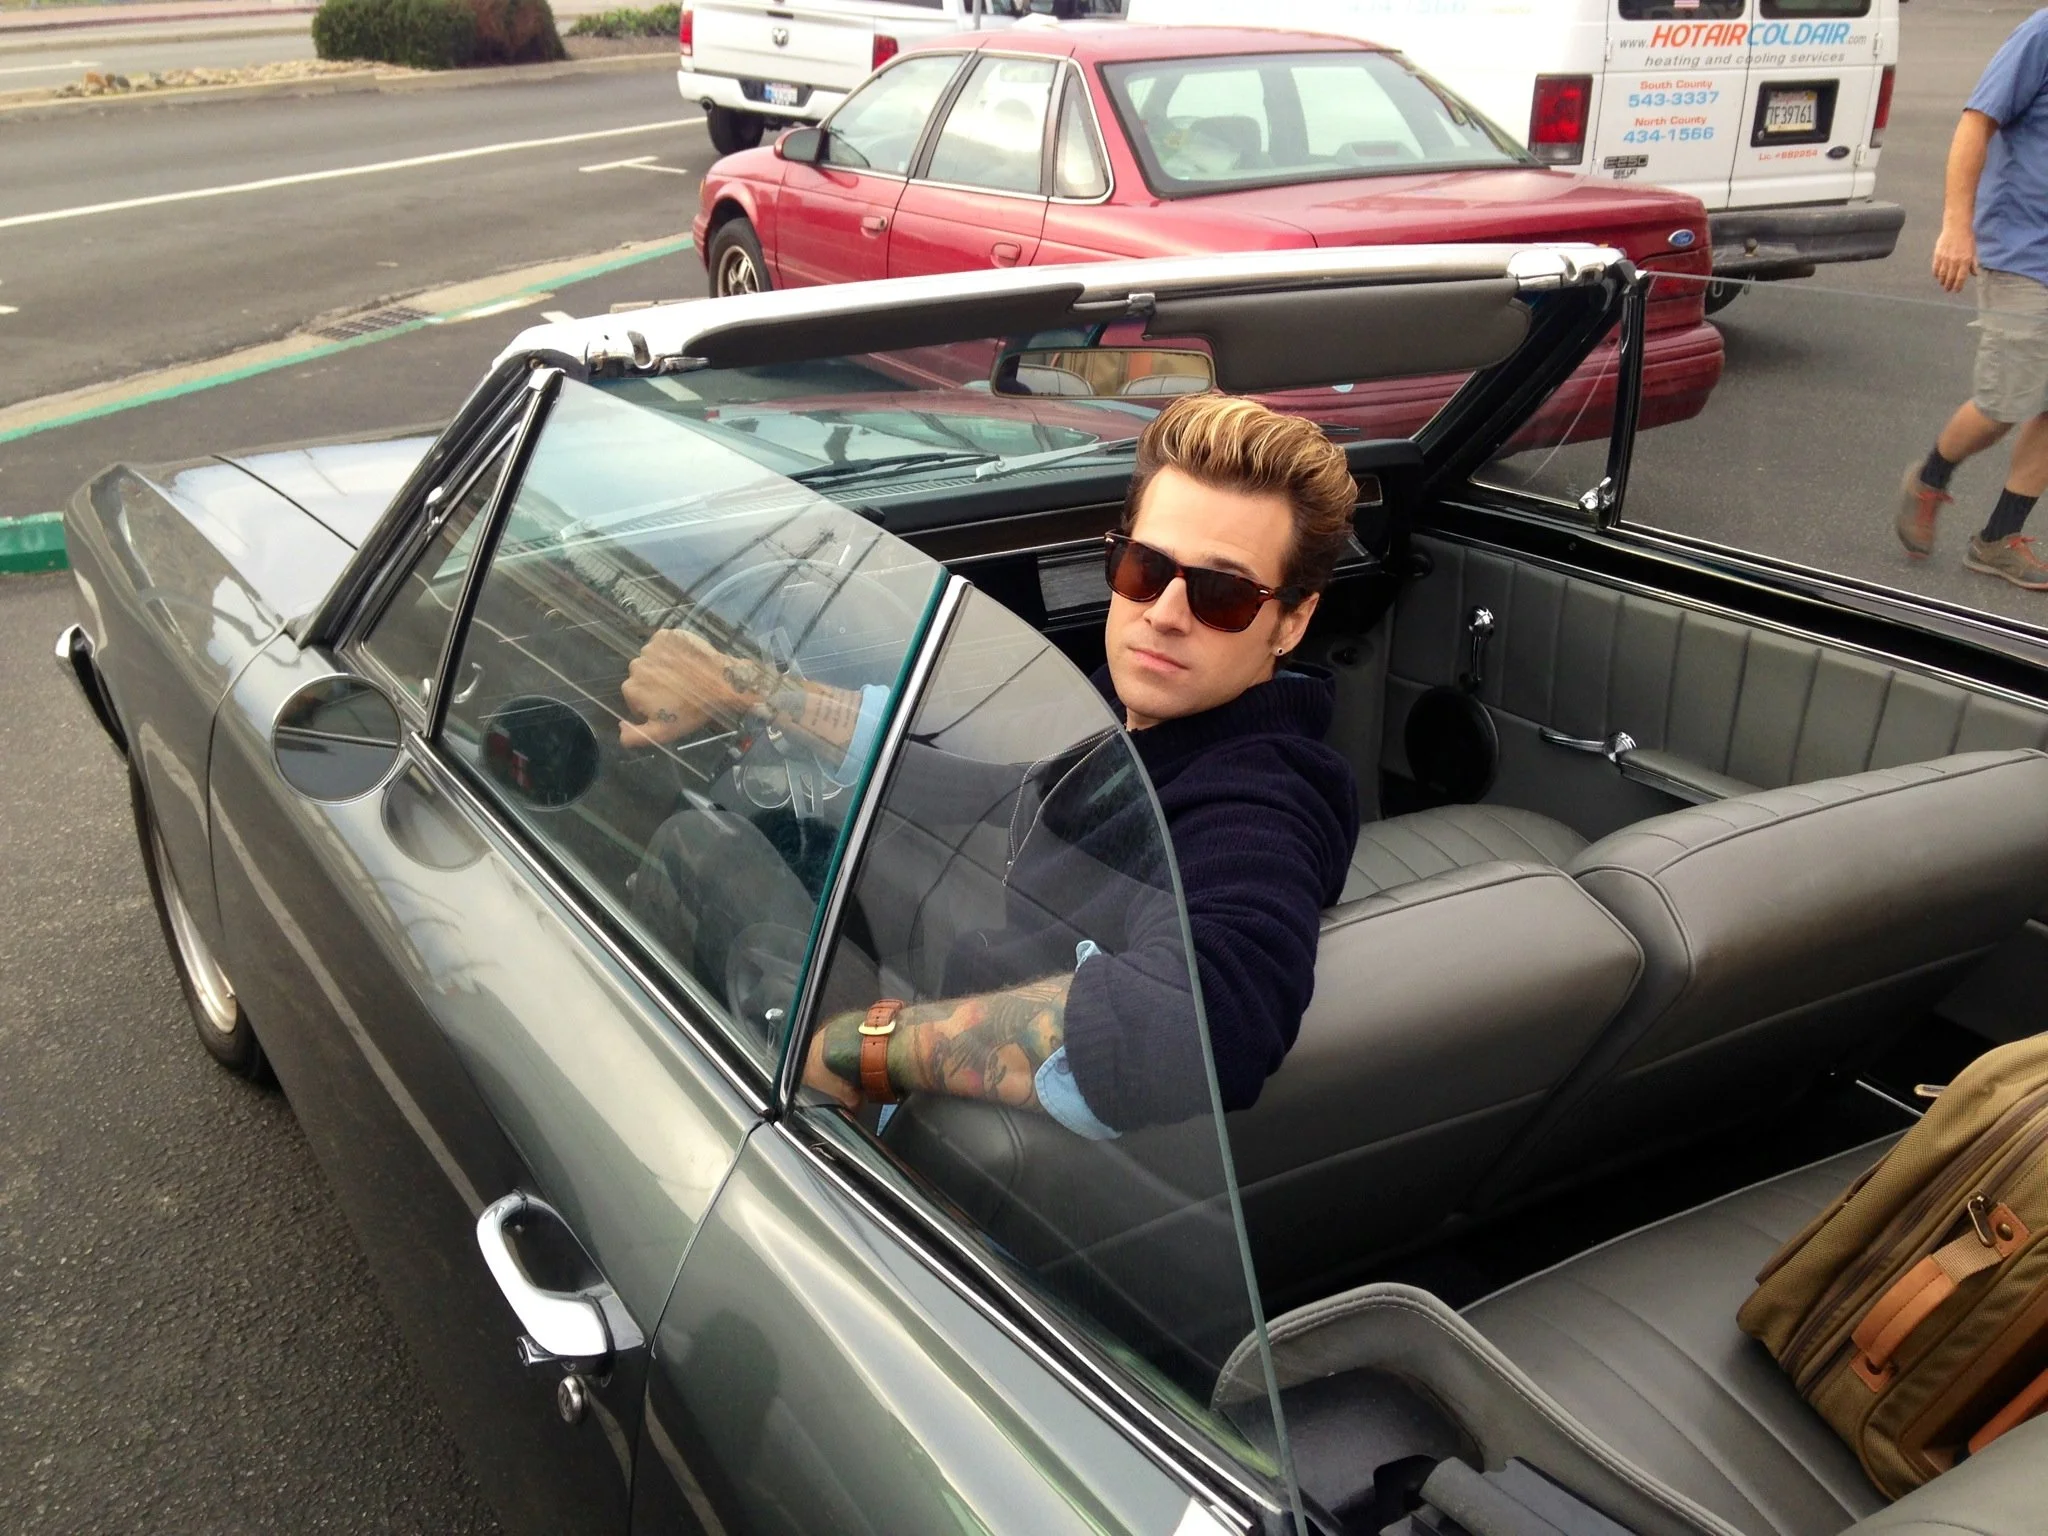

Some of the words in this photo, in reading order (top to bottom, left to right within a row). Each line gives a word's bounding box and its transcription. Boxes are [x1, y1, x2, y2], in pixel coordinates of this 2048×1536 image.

[1644, 54, 1700, 67] heating
[1705, 54, 1732, 65] and
[1735, 53, 1785, 66] cooling
[1789, 53, 1845, 63] services
[1640, 81, 1672, 90] South
[1676, 80, 1713, 89] County
[1628, 91, 1720, 108] 543-3337
[1634, 117, 1667, 126] North
[1670, 116, 1708, 125] County
[1623, 126, 1715, 143] 434-1566
